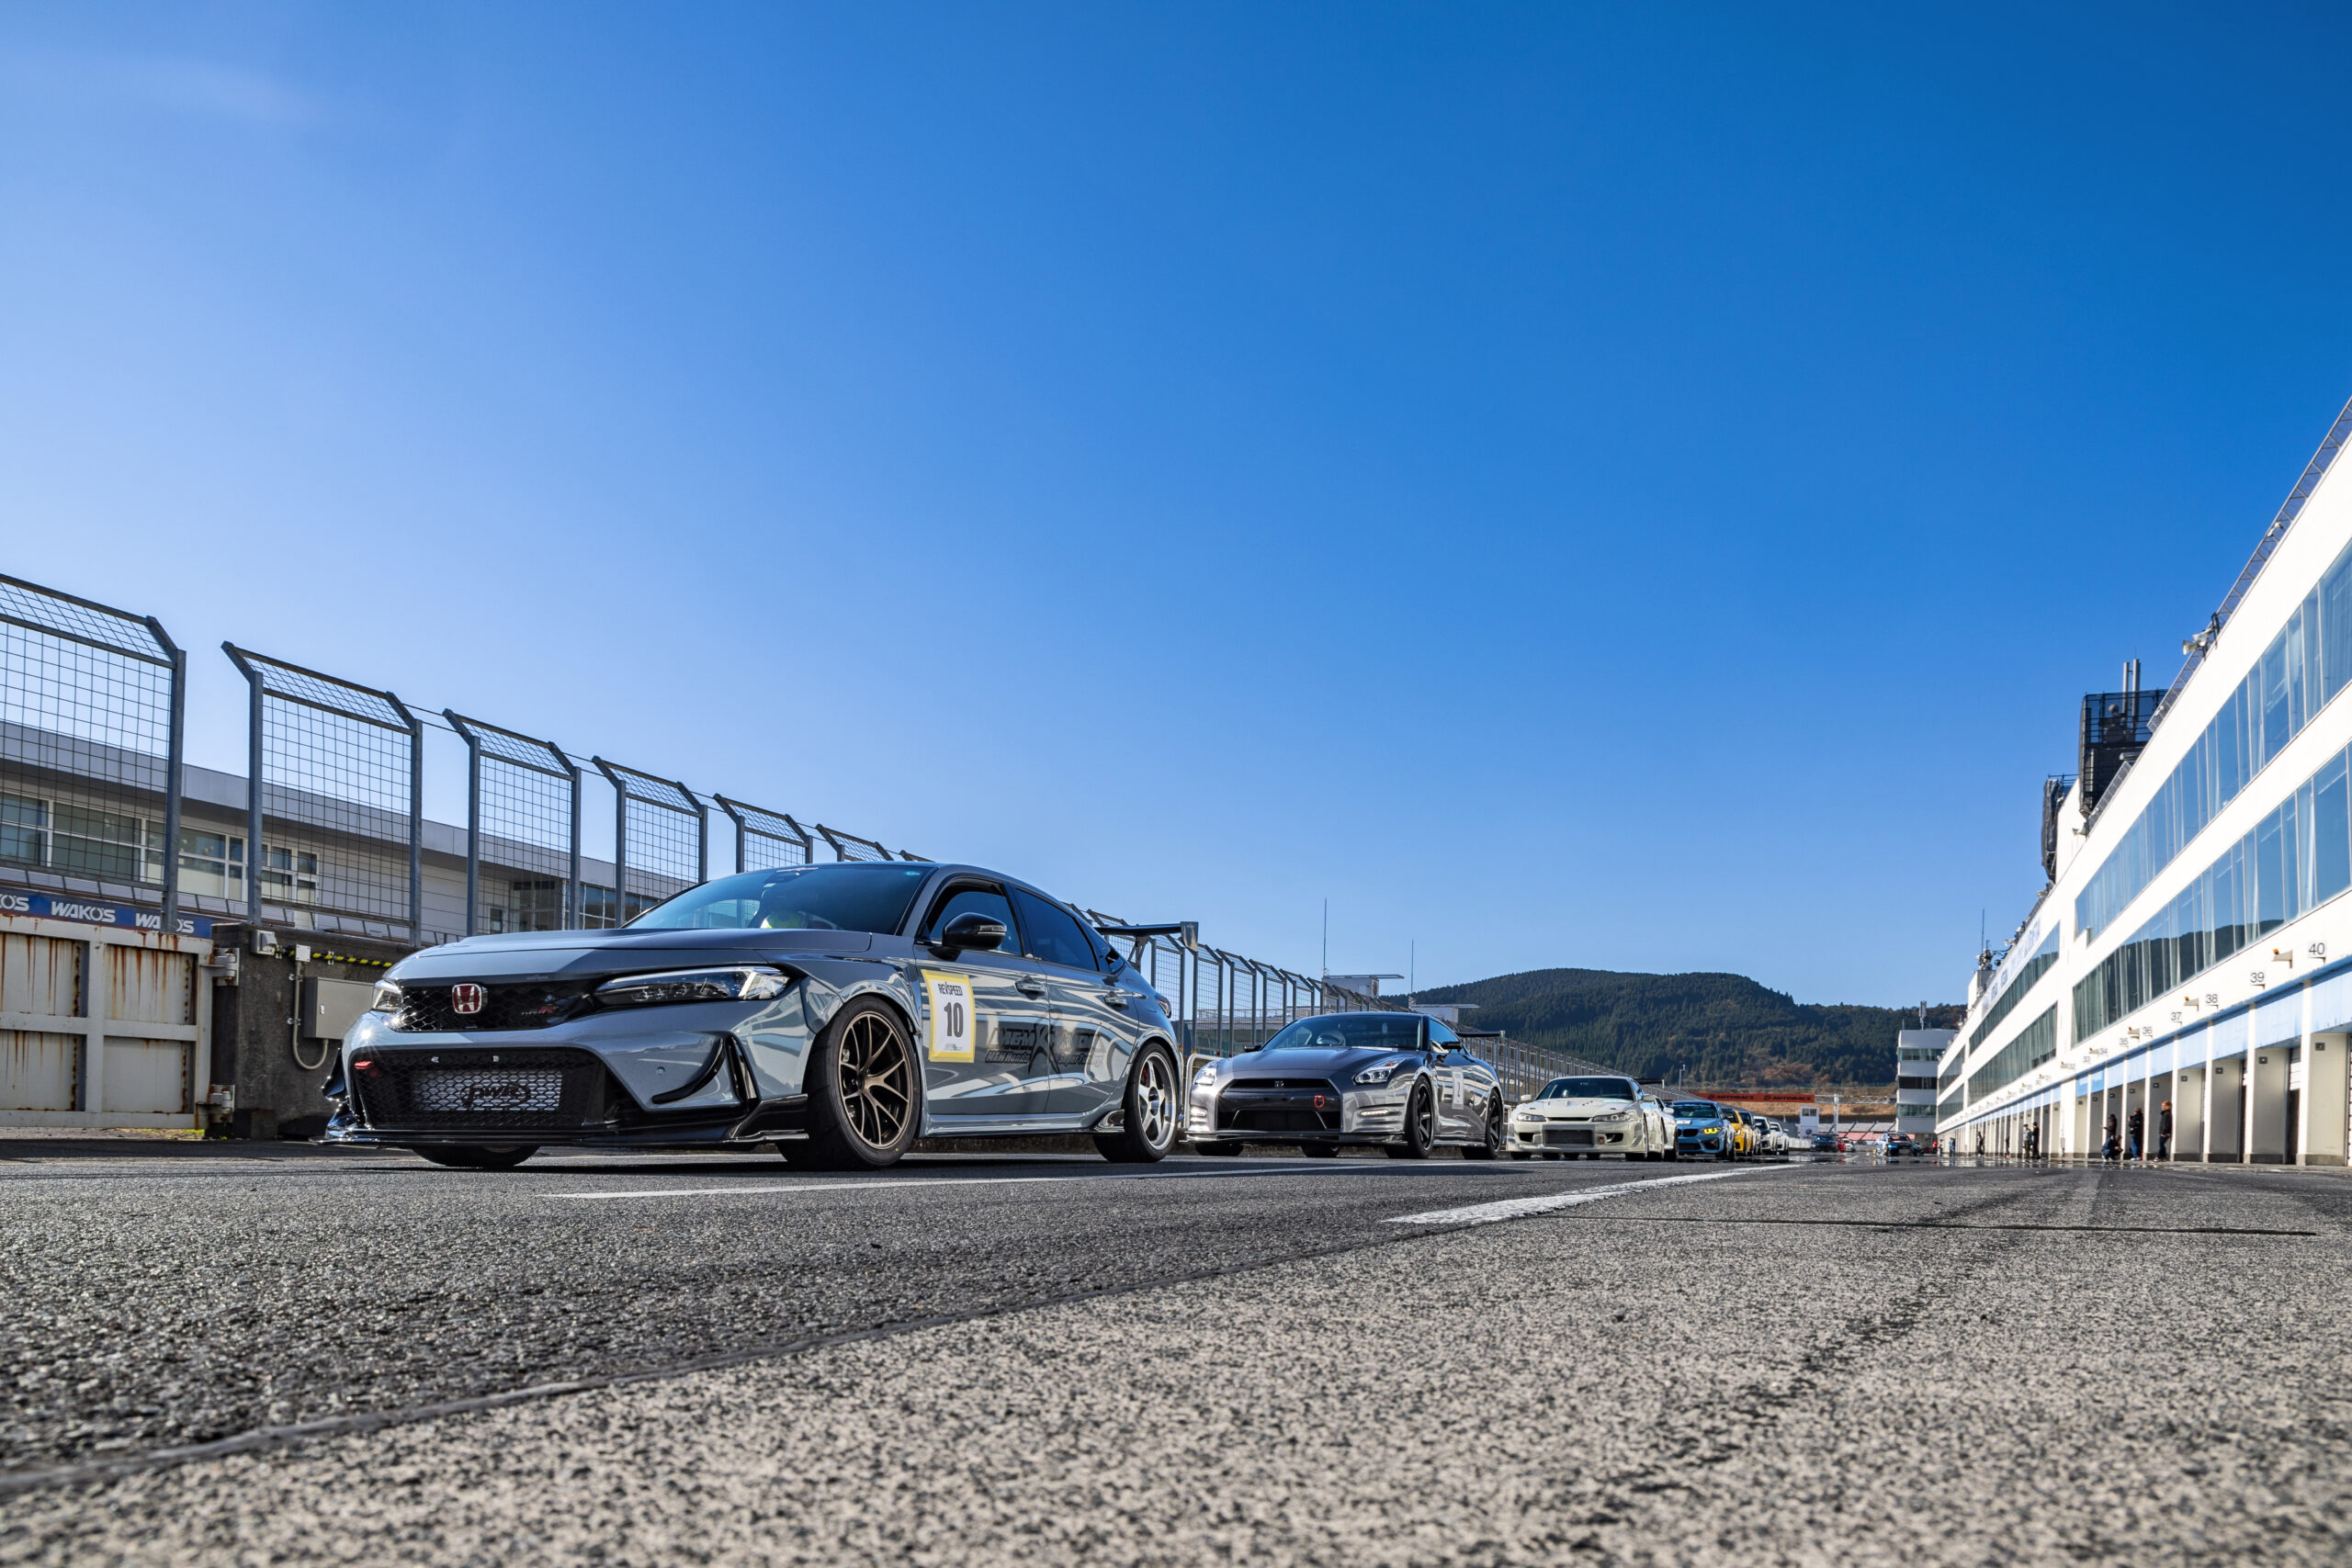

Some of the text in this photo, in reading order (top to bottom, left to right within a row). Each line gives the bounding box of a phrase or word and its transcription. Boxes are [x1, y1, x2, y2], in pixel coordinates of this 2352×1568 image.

[2309, 943, 2325, 954] 40
[2251, 972, 2265, 983] 39
[2206, 994, 2218, 1003] 38
[944, 1001, 964, 1038] 10
[2171, 1012, 2182, 1021] 37
